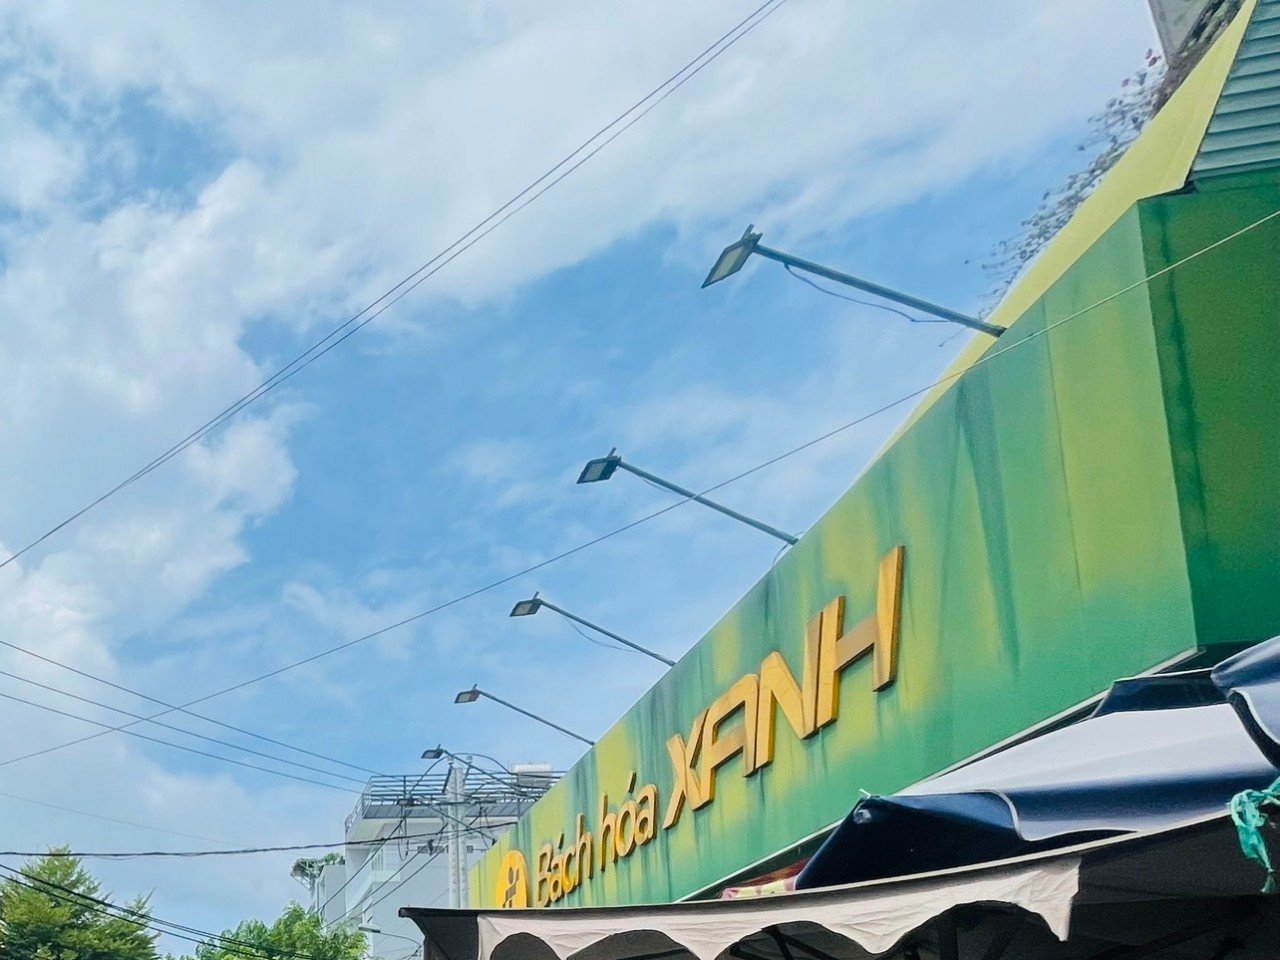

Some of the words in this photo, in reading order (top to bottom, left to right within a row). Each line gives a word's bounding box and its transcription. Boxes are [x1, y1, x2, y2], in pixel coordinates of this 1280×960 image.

[536, 813, 593, 907] Bách
[599, 771, 657, 872] hóa
[663, 546, 905, 830] XANH
